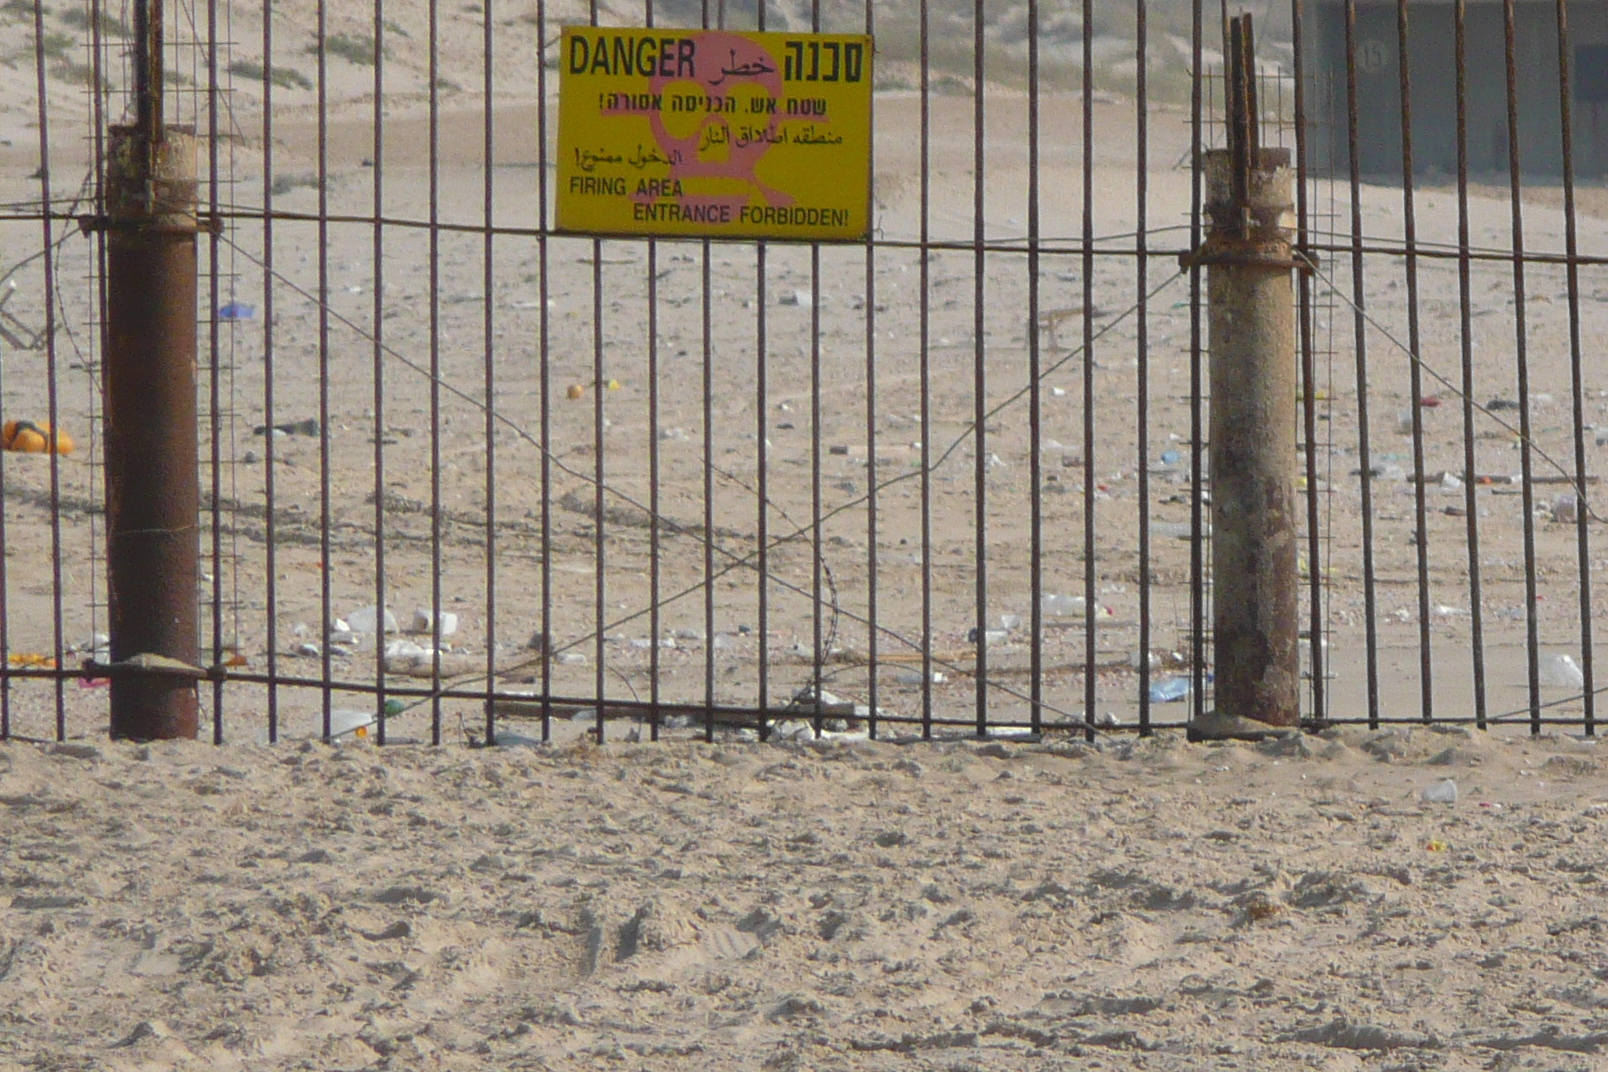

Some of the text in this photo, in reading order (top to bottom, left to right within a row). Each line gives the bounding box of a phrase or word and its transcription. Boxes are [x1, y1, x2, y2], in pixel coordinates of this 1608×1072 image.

[569, 35, 695, 77] DANGER
[708, 48, 775, 85] خطر
[784, 40, 863, 83] סכנה
[598, 92, 826, 115] שטח אש. הכניסה אסורה!
[699, 124, 731, 151] النار
[628, 144, 683, 169] الدخول
[569, 177, 684, 197] FIRING AREA
[633, 203, 849, 227] ENTRANCE FORBIDDEN!
